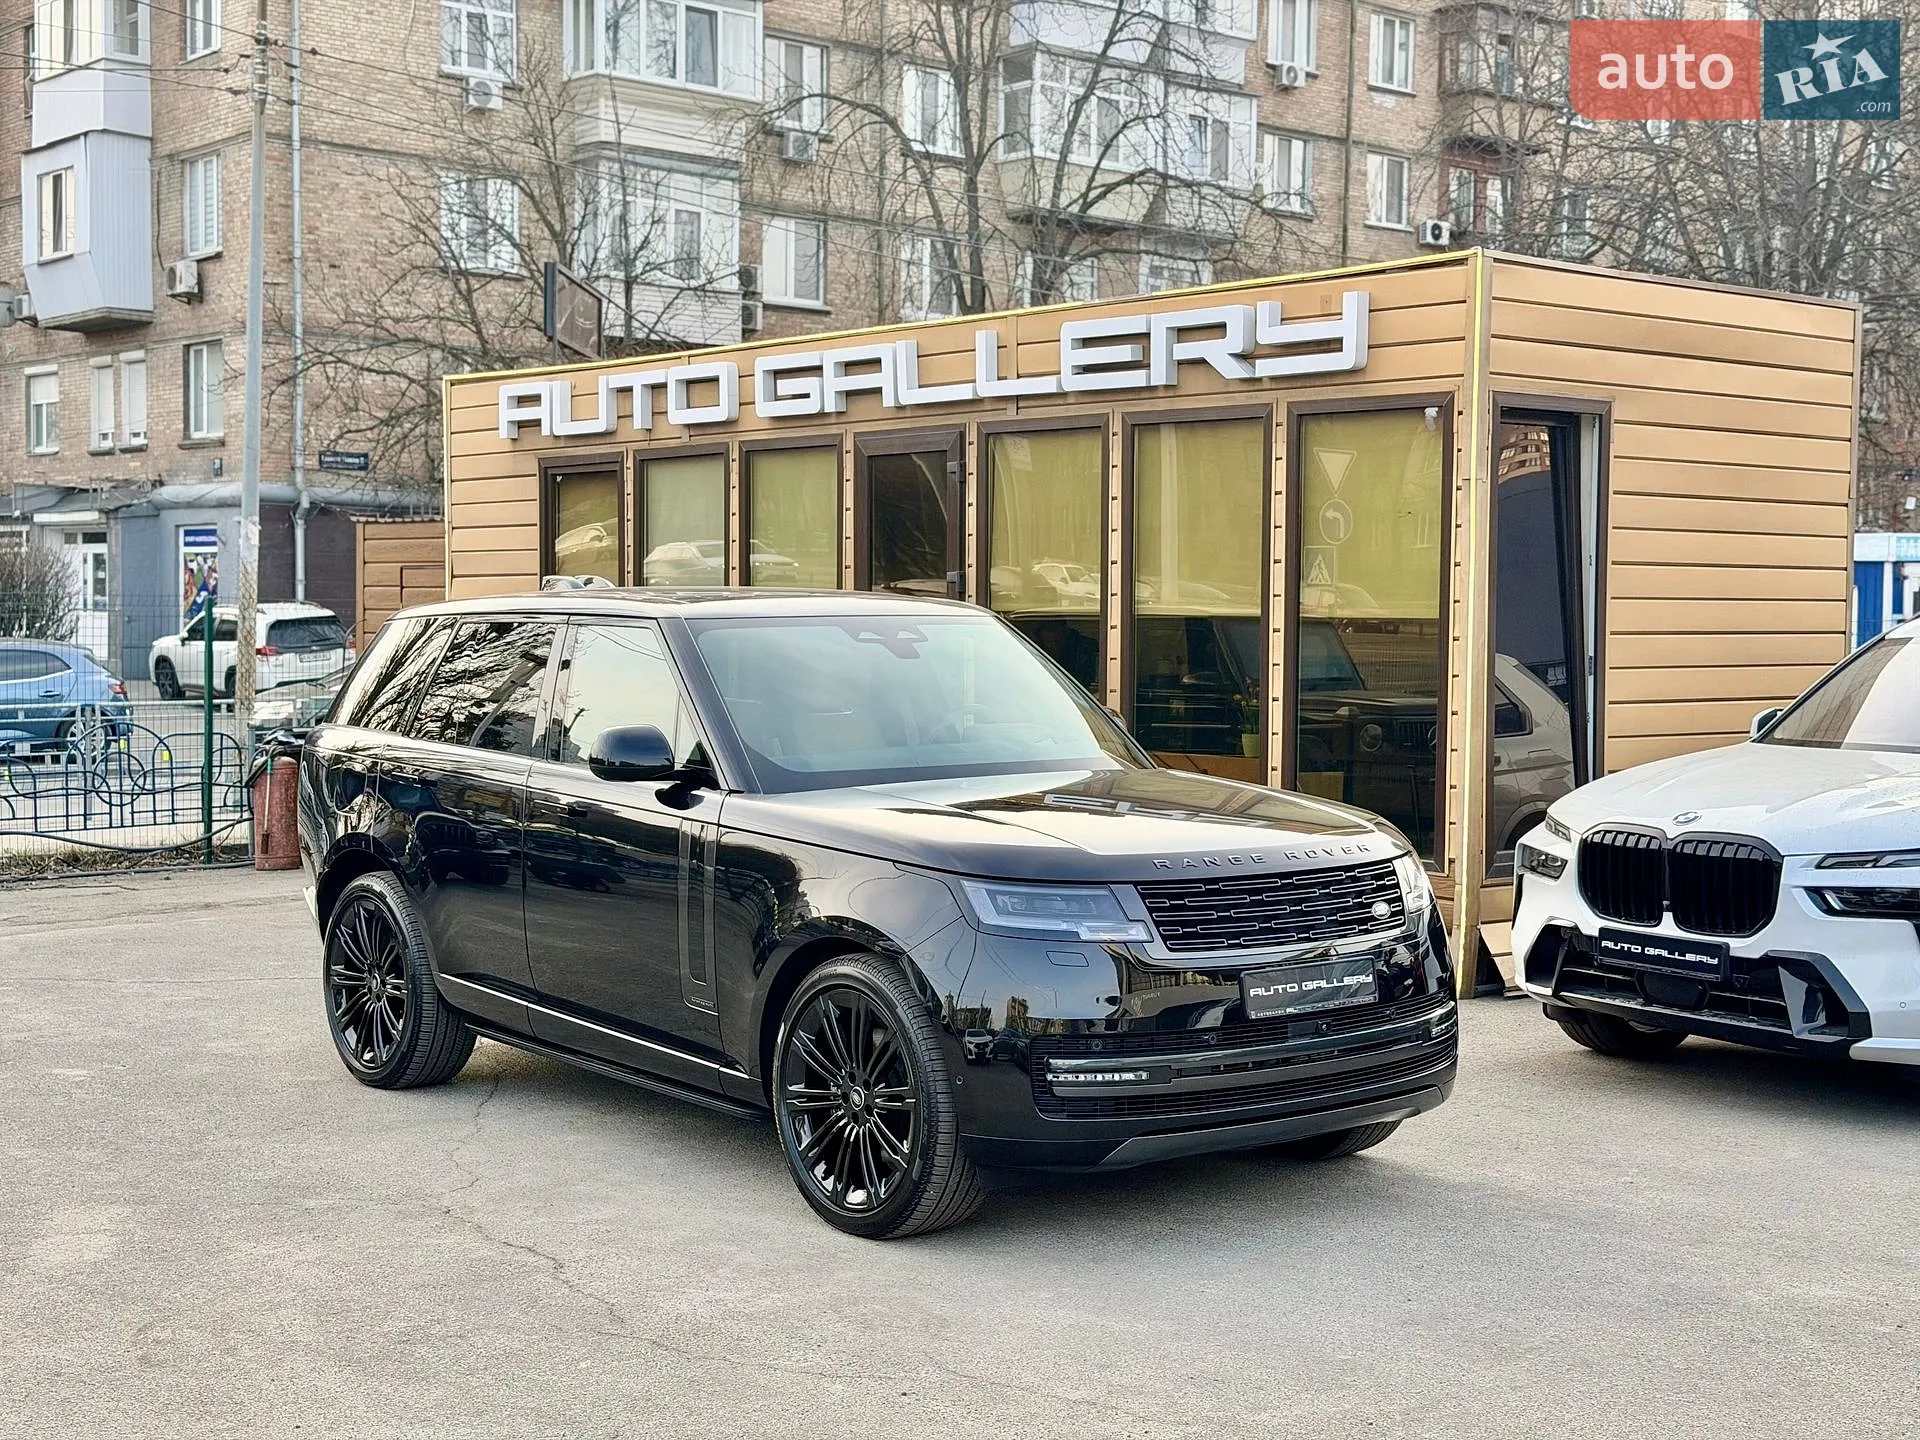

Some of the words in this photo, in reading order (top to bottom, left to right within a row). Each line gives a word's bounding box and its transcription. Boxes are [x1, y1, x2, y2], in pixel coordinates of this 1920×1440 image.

[498, 361, 739, 440] AUTO
[754, 290, 1370, 419] GALLERY
[1152, 853, 1267, 870] RANGE
[1283, 843, 1372, 860] ROVER
[1601, 940, 1642, 953] AUTO
[1644, 947, 1719, 964] GALLERY
[1249, 983, 1299, 997] AUTO
[1301, 974, 1373, 991] GALLERY
